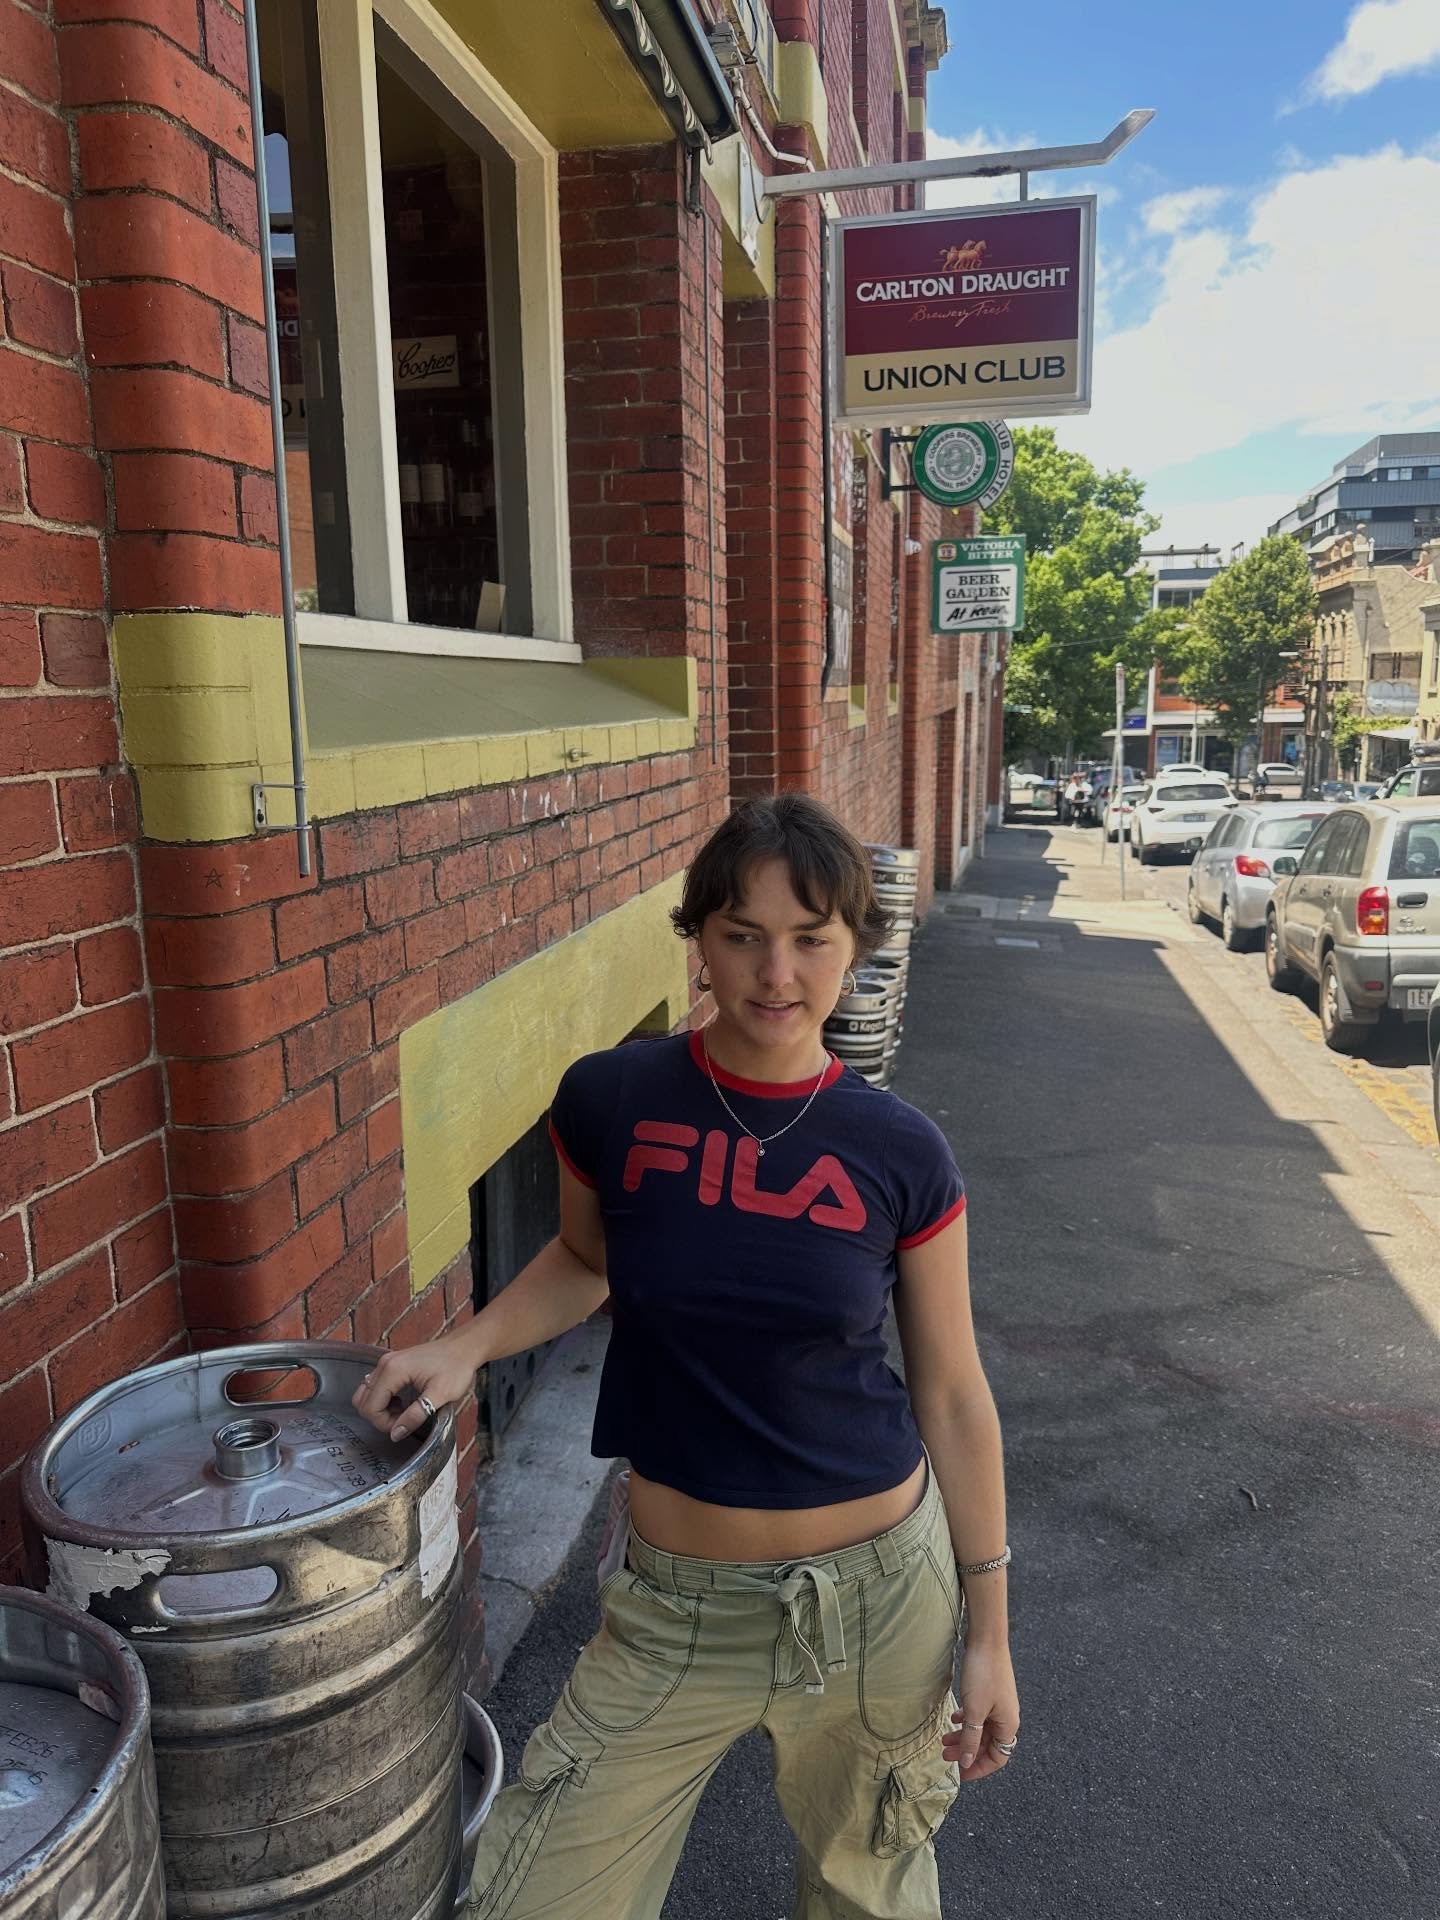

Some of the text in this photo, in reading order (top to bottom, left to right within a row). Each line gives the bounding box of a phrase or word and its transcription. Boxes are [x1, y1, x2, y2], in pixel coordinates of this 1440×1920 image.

[857, 267, 1070, 302] CARLTON DRAUGHT
[909, 299, 1013, 327] Brewery Fresh
[398, 342, 455, 381] Coopers
[864, 356, 1066, 391] UNION CLUB
[928, 431, 955, 459] COOPERS
[983, 459, 1011, 501] HOTEL
[960, 541, 1021, 552] VICTORIA
[967, 550, 1014, 560] BITTER
[945, 586, 1011, 600] GARDEN
[958, 574, 1001, 586] BEER
[623, 1120, 867, 1232] FILA
